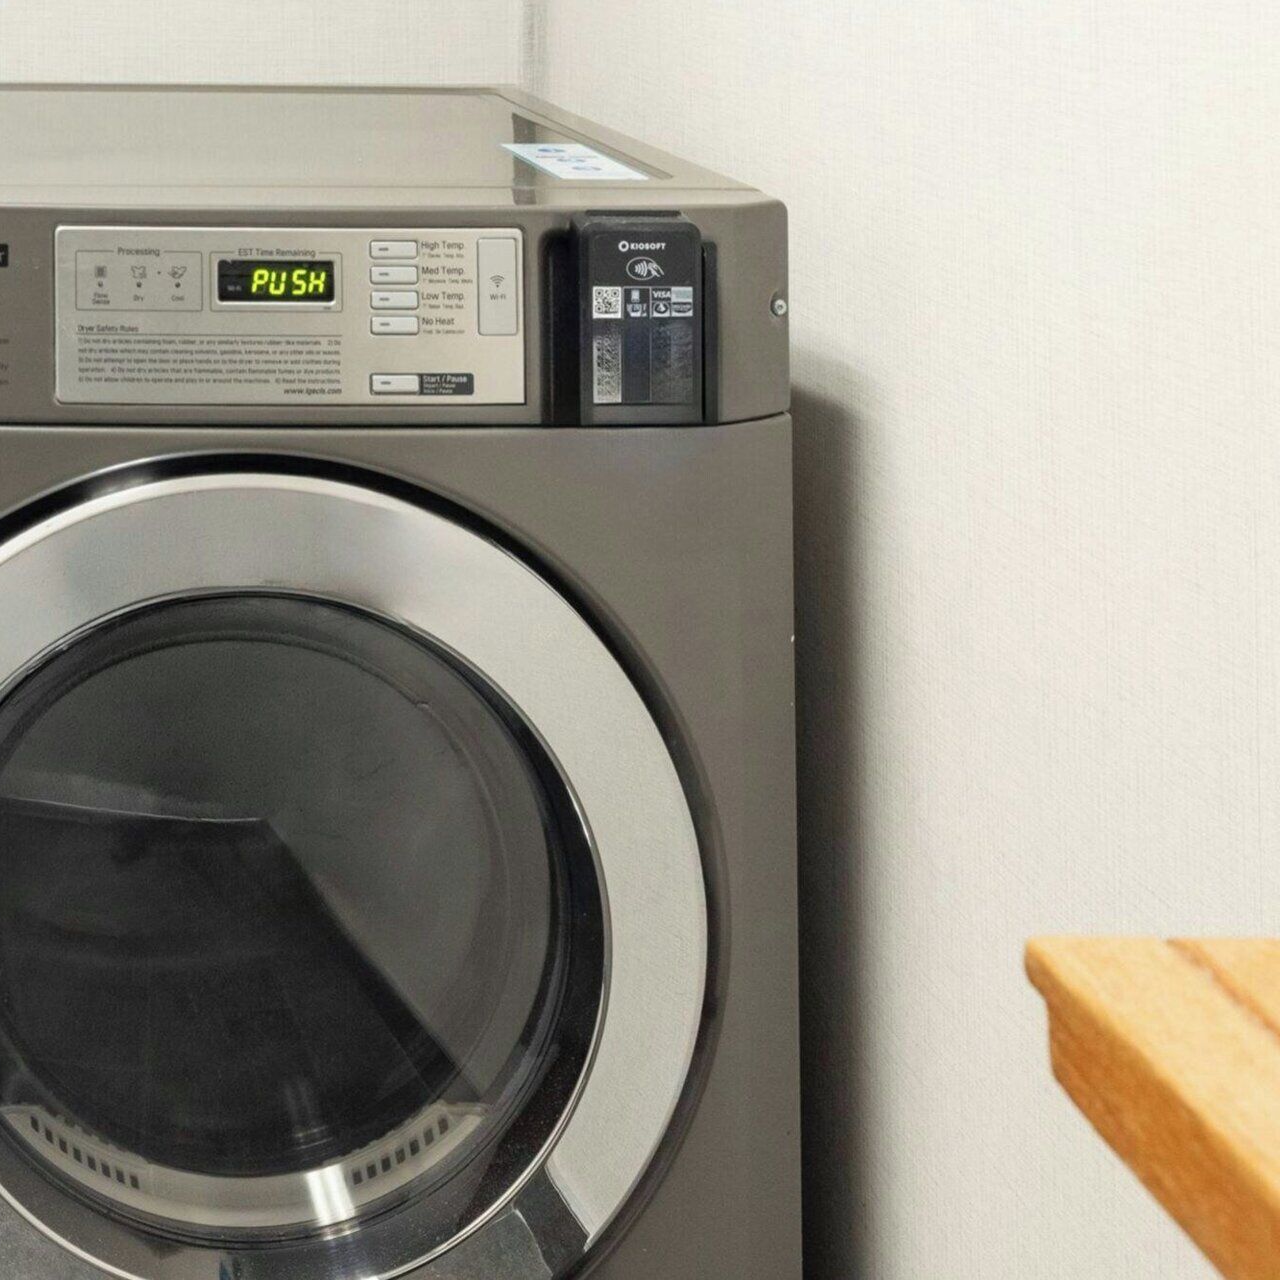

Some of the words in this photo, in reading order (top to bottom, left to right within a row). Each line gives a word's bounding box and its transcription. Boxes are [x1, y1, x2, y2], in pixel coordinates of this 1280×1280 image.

[421, 241, 440, 251] High
[442, 241, 464, 251] Temp
[630, 242, 666, 250] KIOSOFT
[117, 248, 160, 257] Processing
[238, 248, 253, 256] EST
[275, 249, 316, 258] Remaining
[421, 266, 441, 275] Med
[442, 266, 464, 277] Temp
[251, 269, 326, 295] PUSH
[133, 294, 144, 302] Dry
[421, 291, 440, 301] Low
[442, 291, 464, 302] Temp
[422, 317, 434, 325] No
[435, 317, 455, 325] Heat
[77, 324, 95, 333] Dryer
[96, 324, 120, 333] Safety
[121, 324, 139, 332] Rules
[423, 375, 440, 383] Start
[447, 375, 467, 383] Pause
